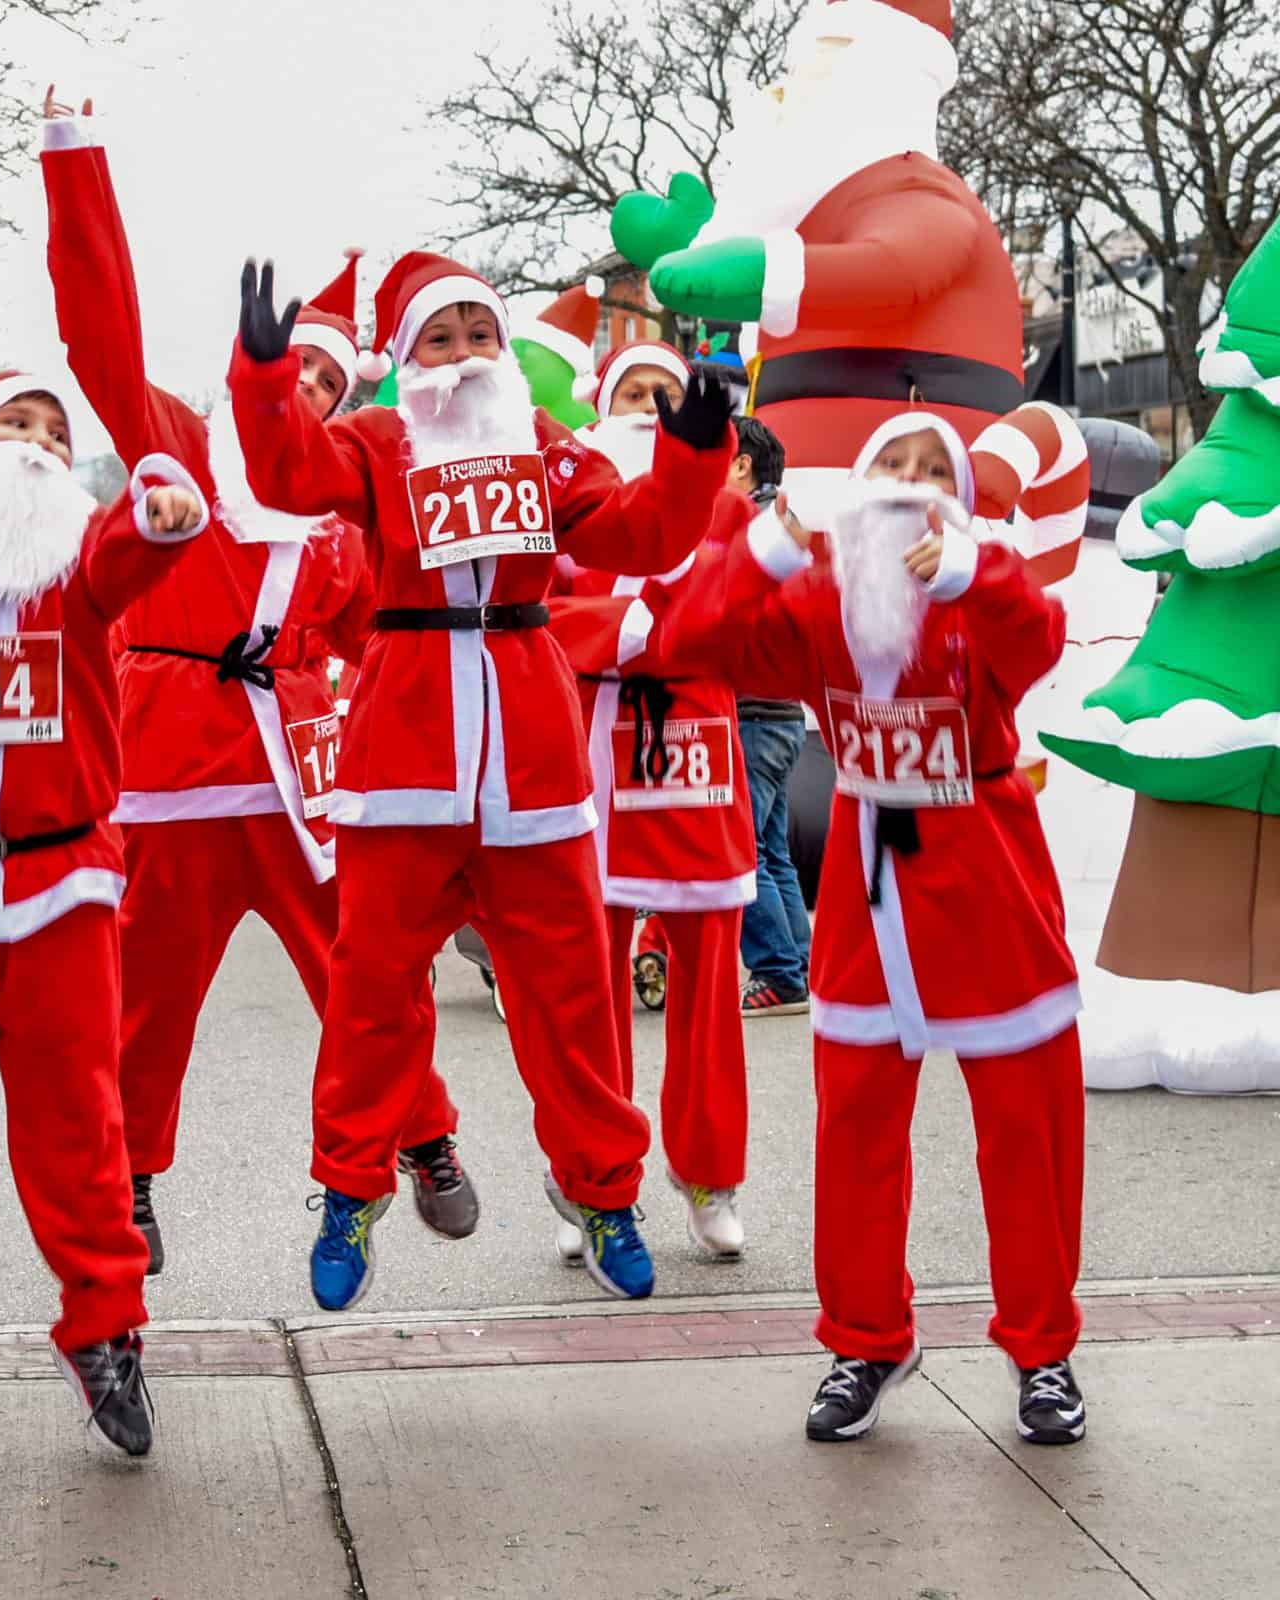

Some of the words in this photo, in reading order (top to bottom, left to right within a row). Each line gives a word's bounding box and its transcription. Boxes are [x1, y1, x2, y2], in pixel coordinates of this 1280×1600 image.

[449, 456, 504, 481] Running
[423, 480, 544, 545] 2128
[523, 536, 552, 550] 2128
[839, 719, 960, 784] 2124
